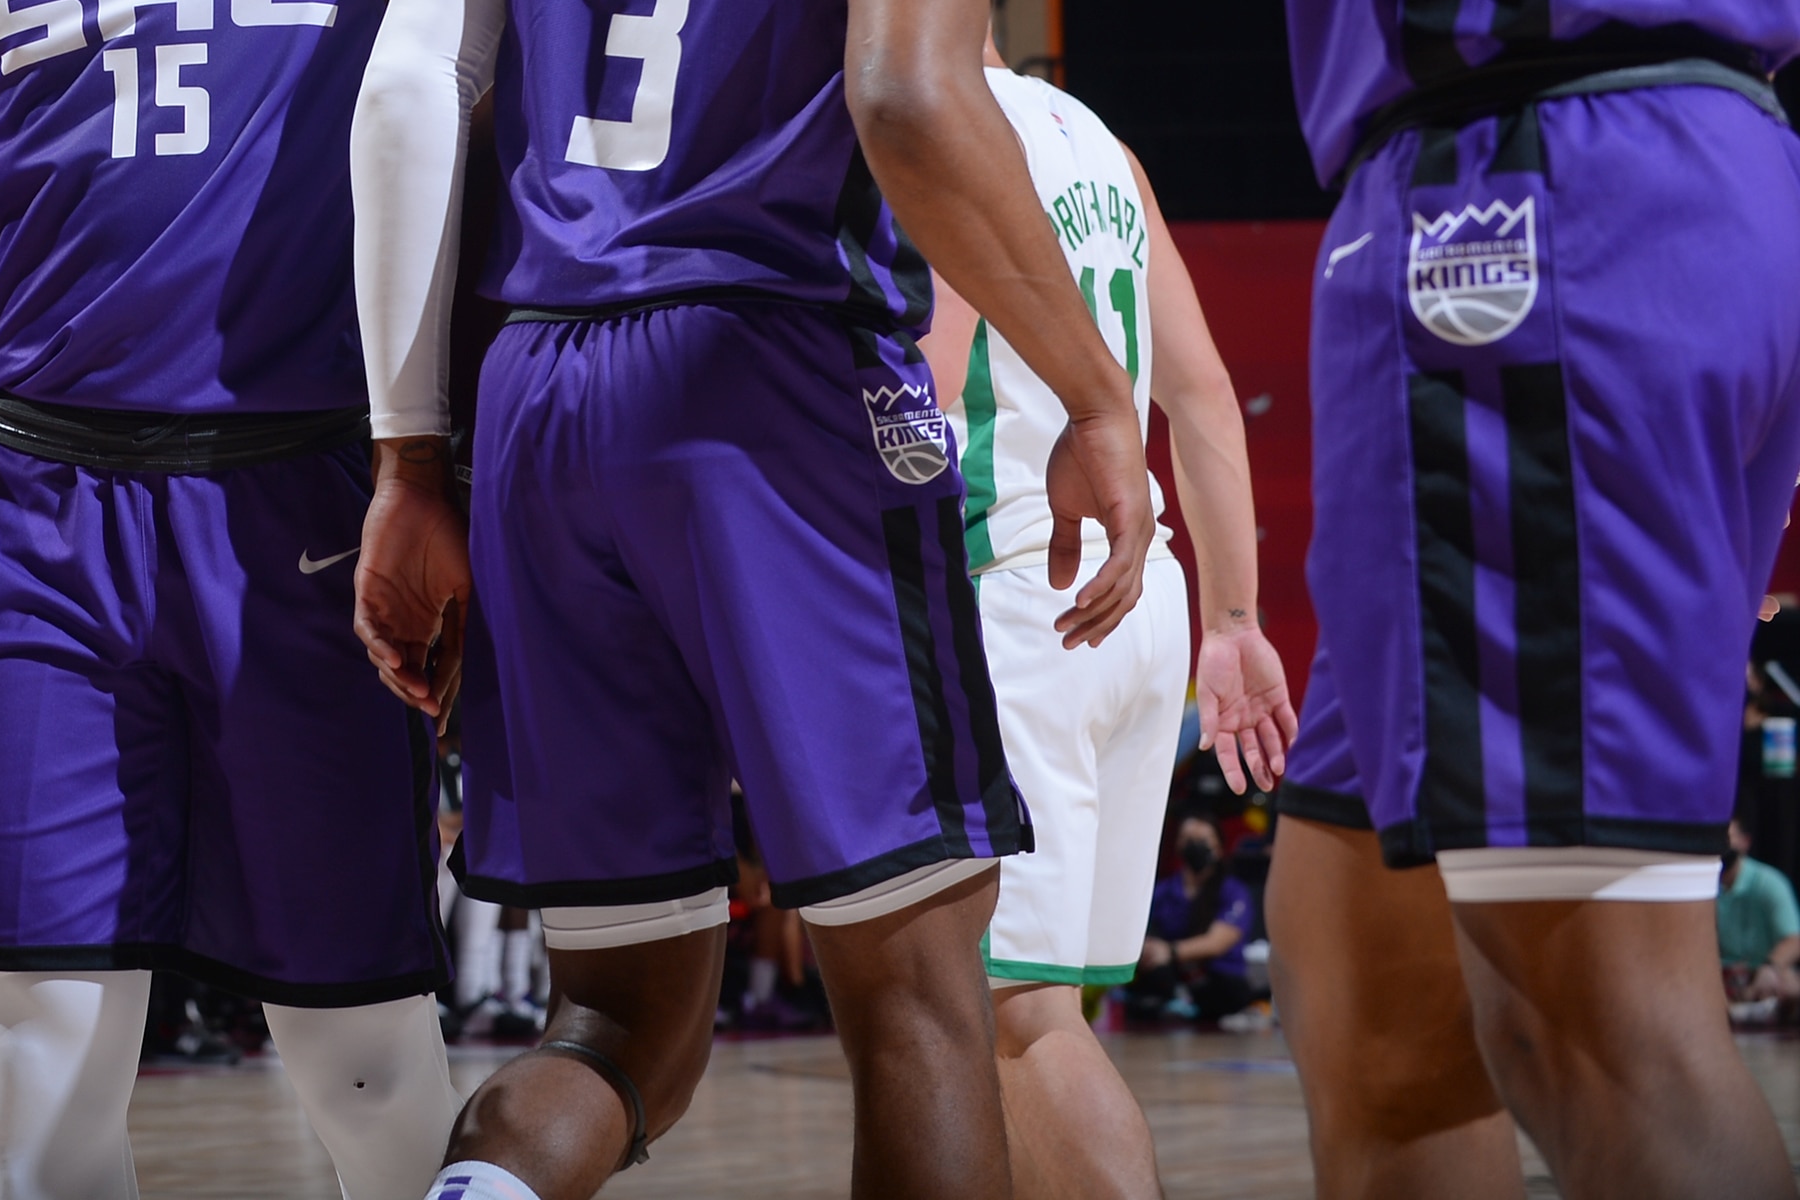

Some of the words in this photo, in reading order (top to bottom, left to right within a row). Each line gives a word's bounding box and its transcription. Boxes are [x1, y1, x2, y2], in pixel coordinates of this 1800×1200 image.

[103, 43, 210, 158] 15
[1416, 260, 1529, 291] KINGS
[876, 408, 942, 426] SACRAMENTO
[878, 422, 943, 449] KINGS
